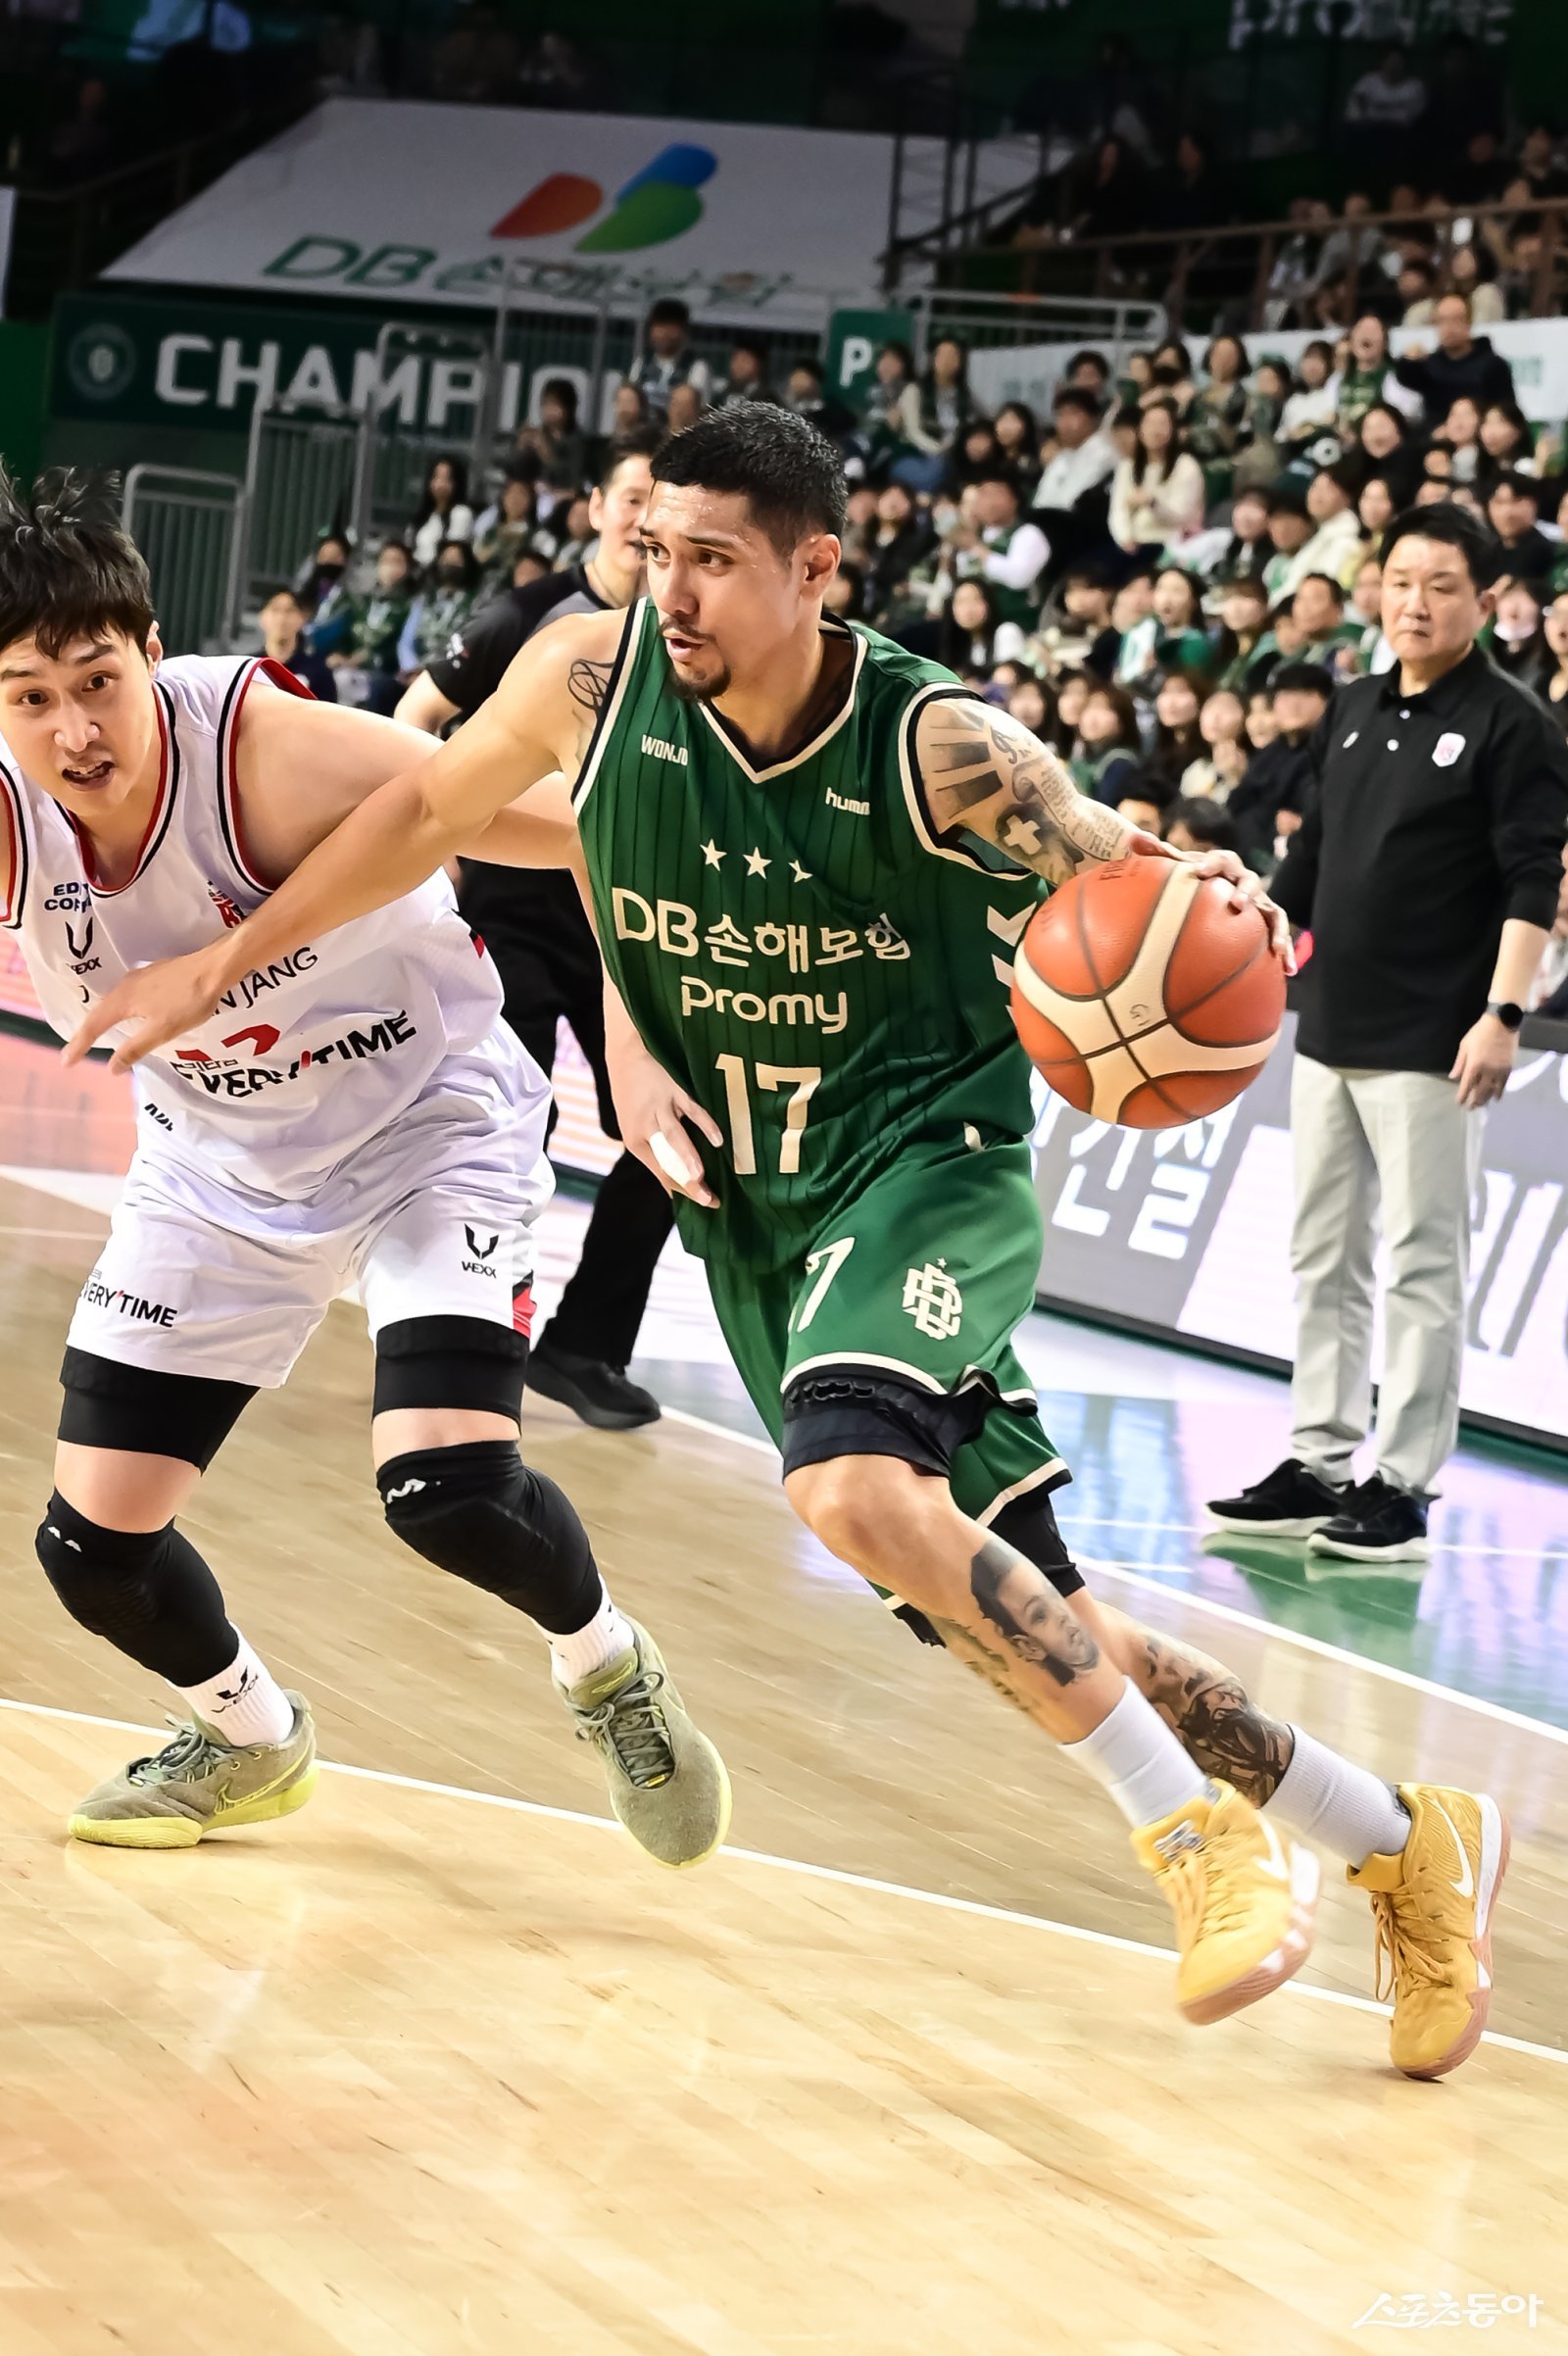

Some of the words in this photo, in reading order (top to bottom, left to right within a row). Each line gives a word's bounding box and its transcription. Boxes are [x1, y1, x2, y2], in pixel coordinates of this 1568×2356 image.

[612, 887, 911, 973] DB손해보험
[680, 975, 849, 1035] promy
[714, 1052, 823, 1176] 17
[82, 1281, 178, 1329] VERY'TIME
[787, 1236, 856, 1334] 7
